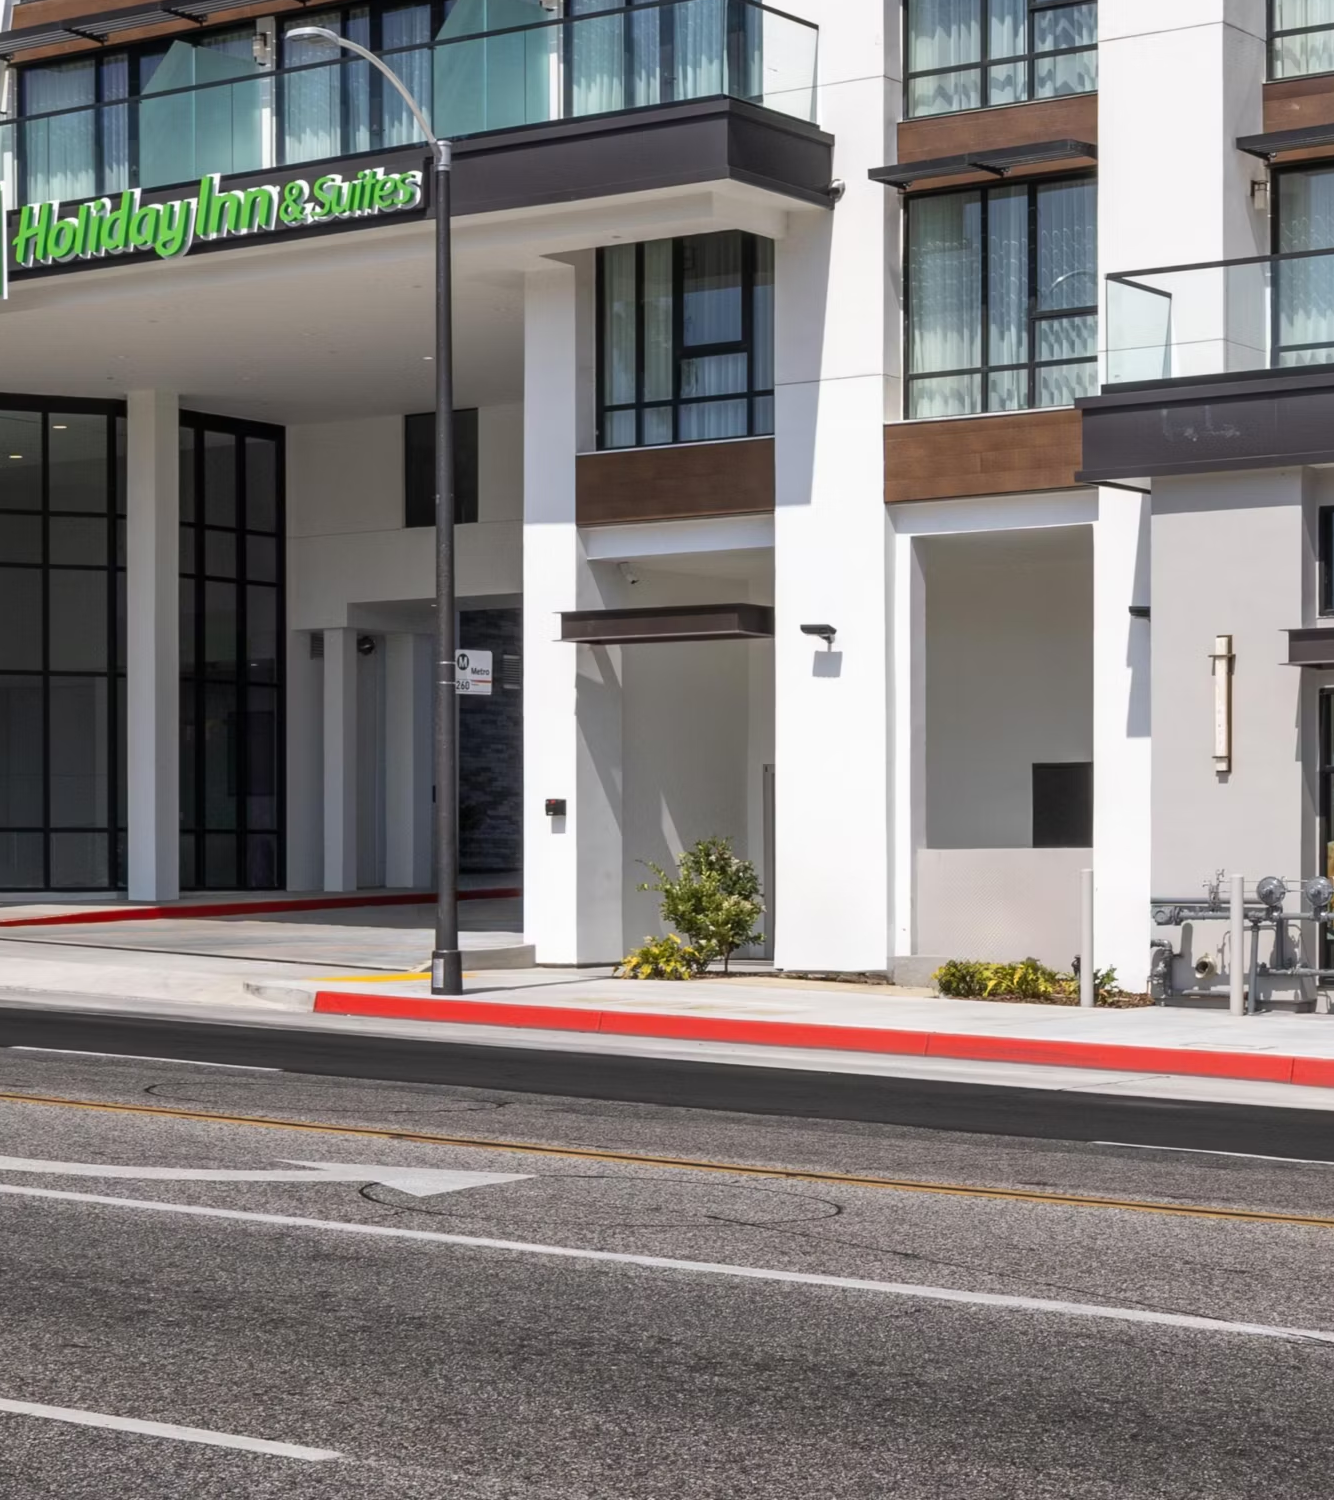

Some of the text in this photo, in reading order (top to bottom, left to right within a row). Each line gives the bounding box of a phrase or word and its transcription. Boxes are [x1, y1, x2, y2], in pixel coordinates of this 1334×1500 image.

[12, 188, 196, 264] Holiday
[195, 173, 278, 238] Inn
[279, 180, 310, 225] &
[311, 168, 420, 220] Suites
[471, 667, 490, 676] Metro
[456, 680, 470, 691] 260
